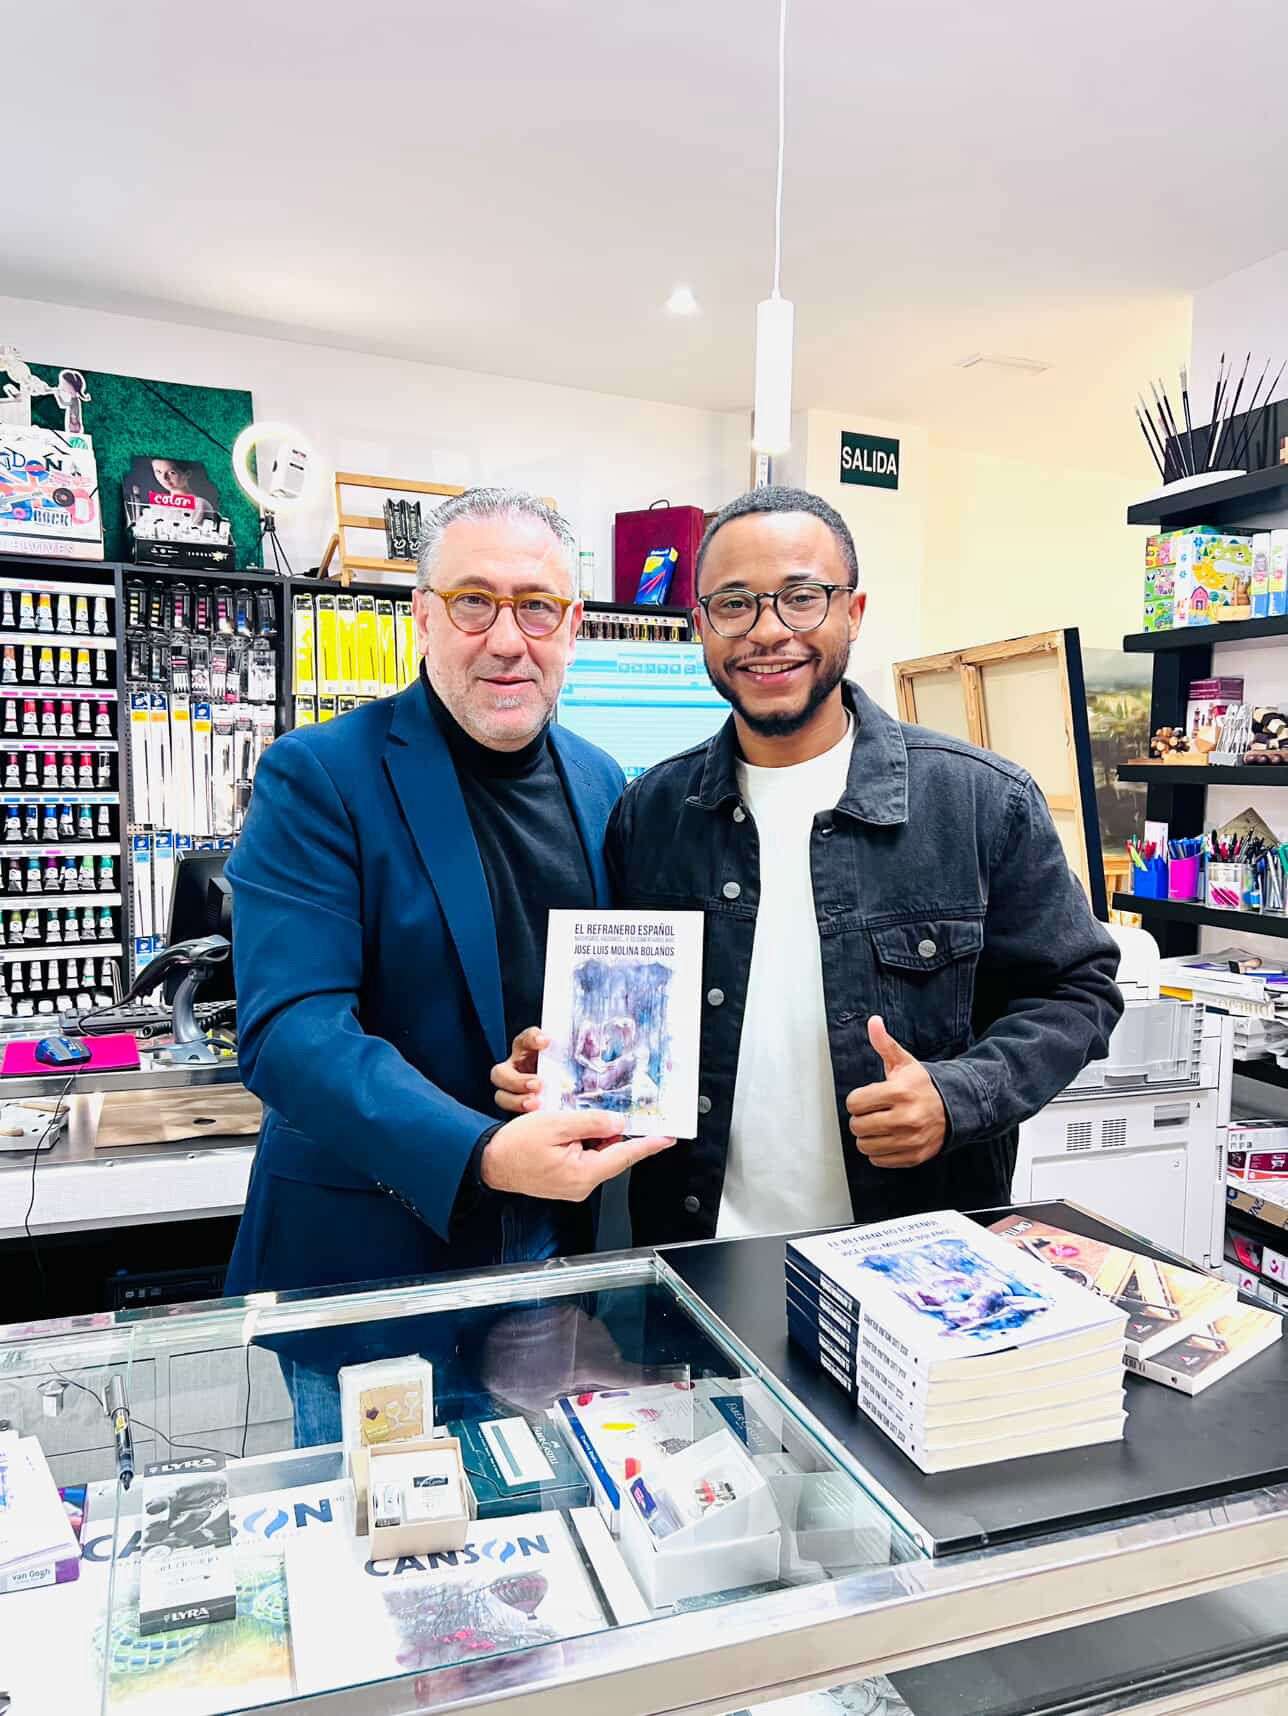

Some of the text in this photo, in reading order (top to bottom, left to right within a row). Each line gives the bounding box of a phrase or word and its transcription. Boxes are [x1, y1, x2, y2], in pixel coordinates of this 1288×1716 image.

[842, 446, 897, 475] SALIDA
[154, 494, 192, 506] color
[575, 922, 674, 936] EL REFRANERO ESPAÑOL
[592, 945, 609, 955] LUIS
[611, 945, 639, 956] MOLINA
[161, 1457, 217, 1473] LYRA
[364, 1534, 552, 1577] CANSON
[12, 1567, 51, 1581] van Gogh
[171, 1607, 210, 1621] LYRA
